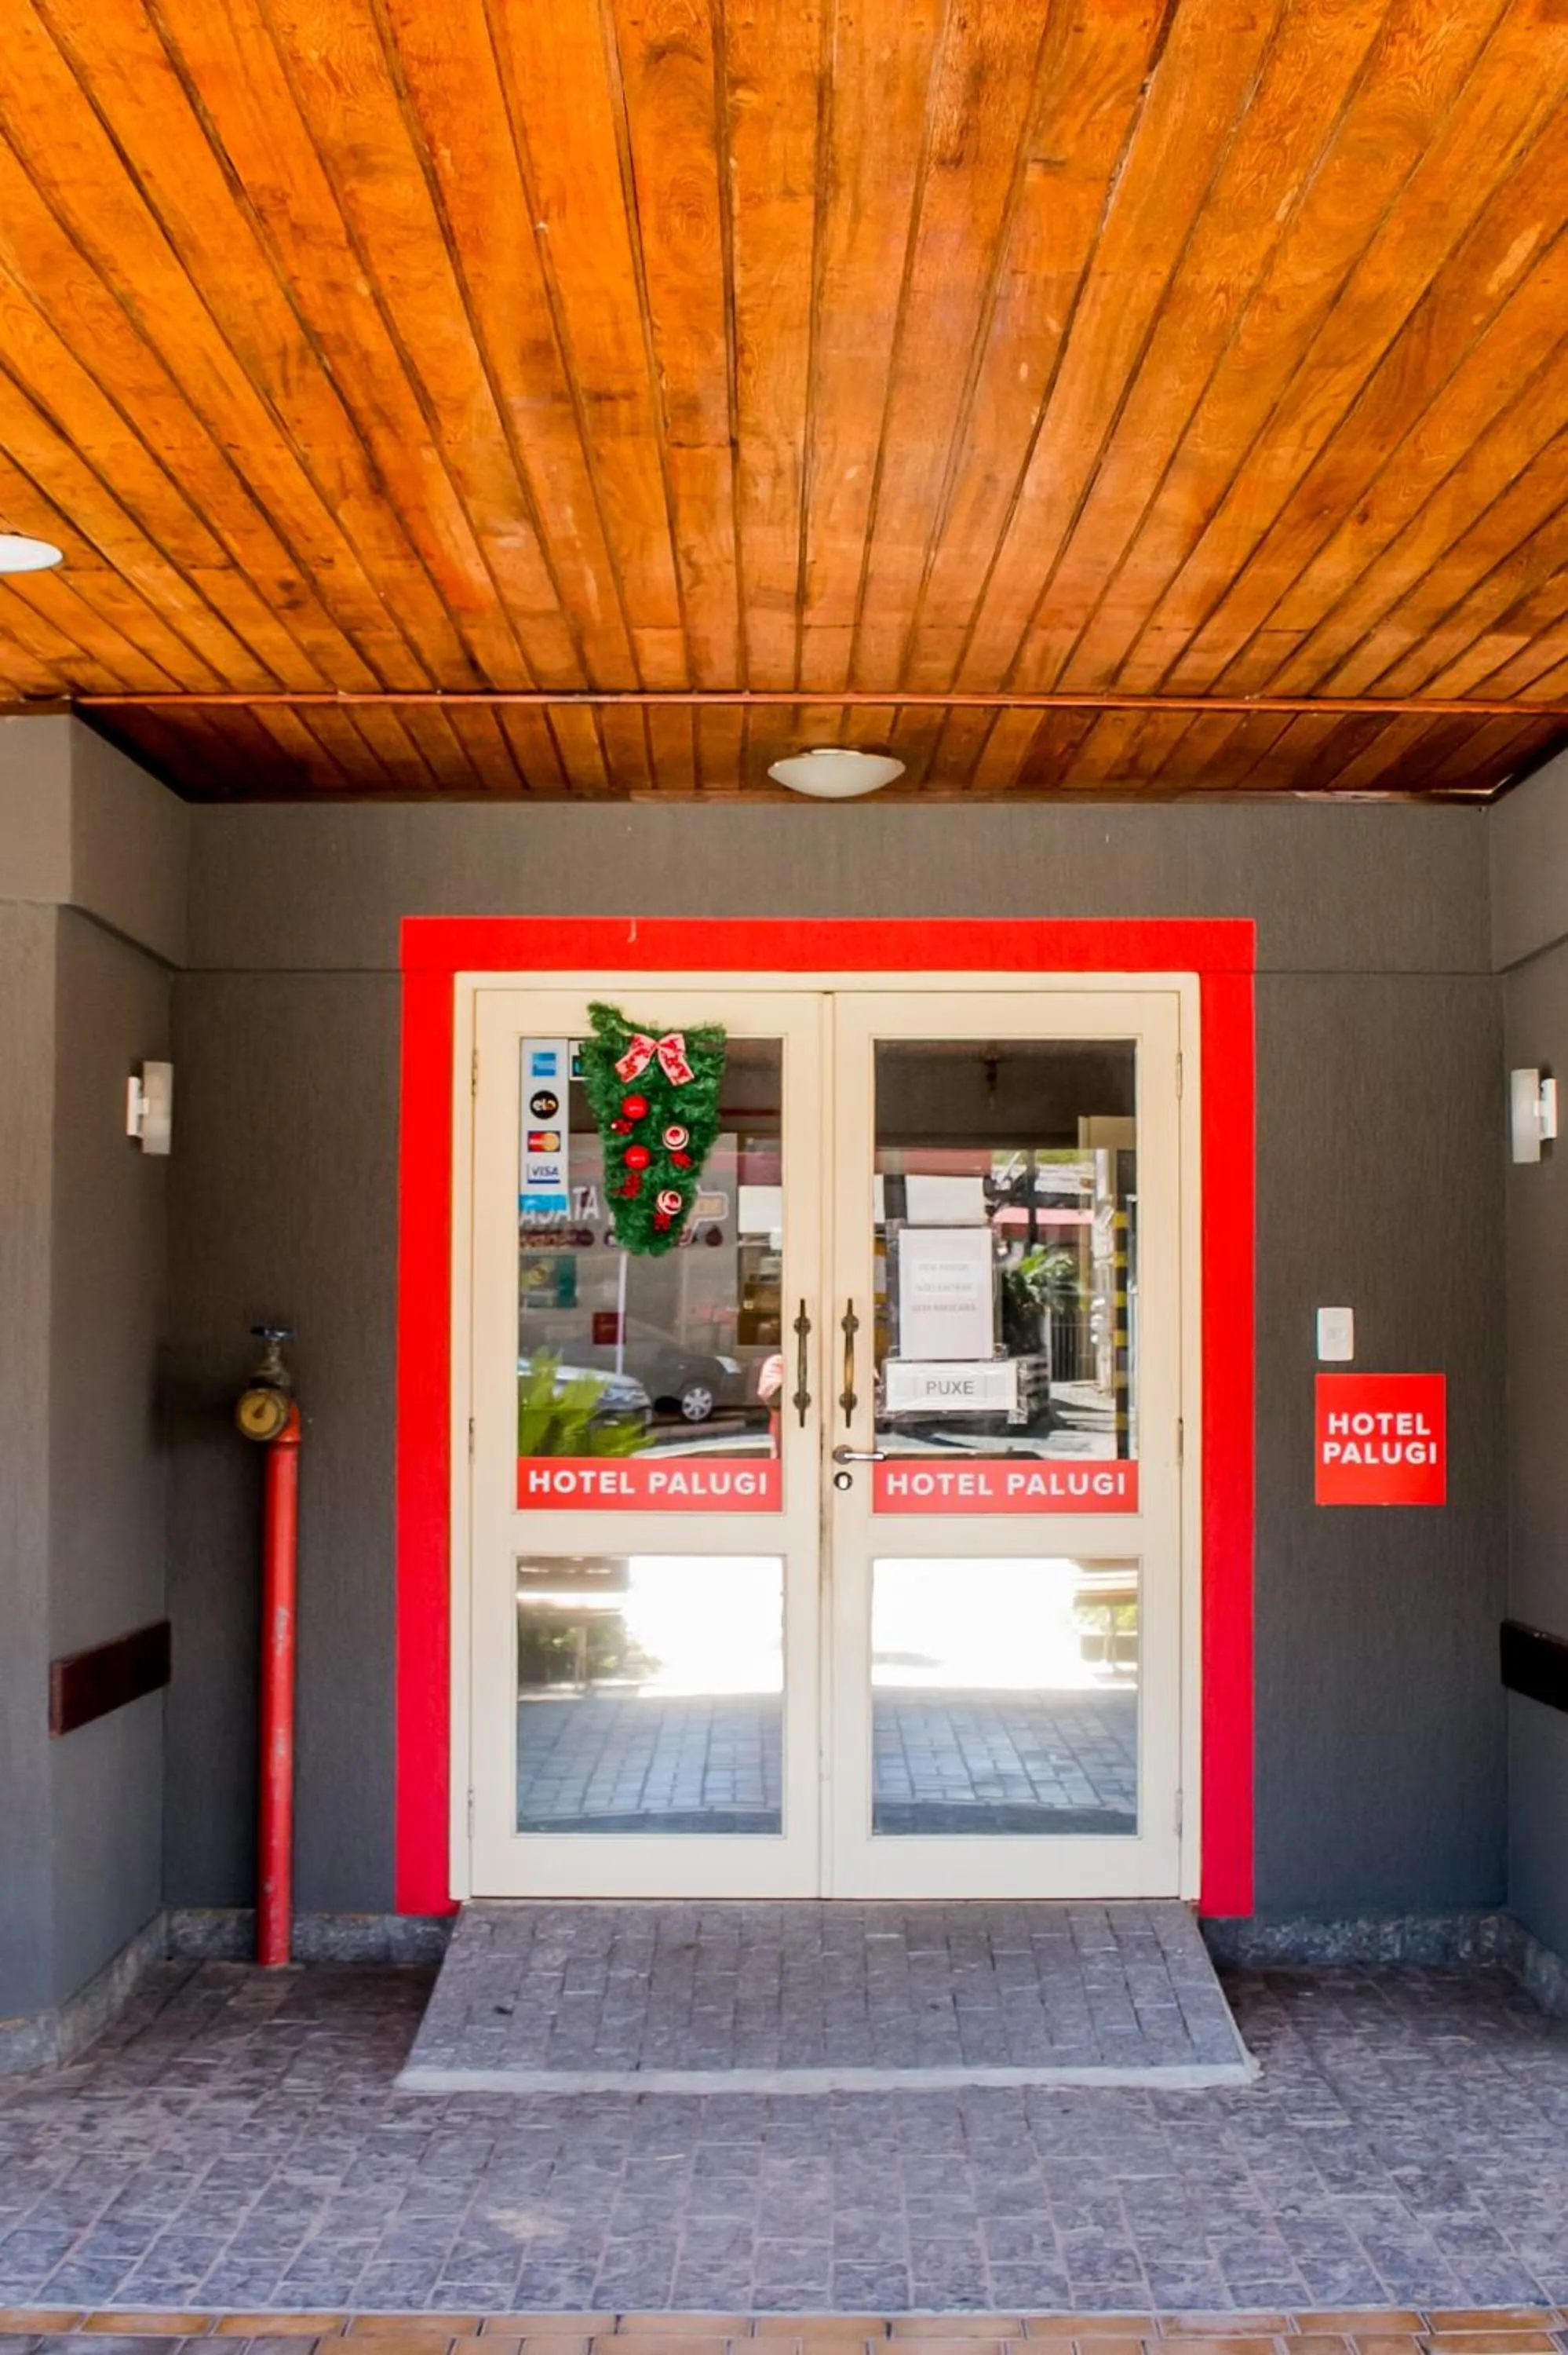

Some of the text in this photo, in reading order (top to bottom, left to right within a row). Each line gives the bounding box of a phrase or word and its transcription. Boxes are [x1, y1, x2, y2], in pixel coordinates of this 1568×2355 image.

[532, 1166, 559, 1178] VISA
[925, 1380, 975, 1395] PUXE
[1328, 1412, 1431, 1435] HOTEL
[1322, 1441, 1437, 1465] PALUGI
[528, 1470, 768, 1495] HOTEL PALUGI
[886, 1473, 1125, 1495] HOTEL PALUGI
